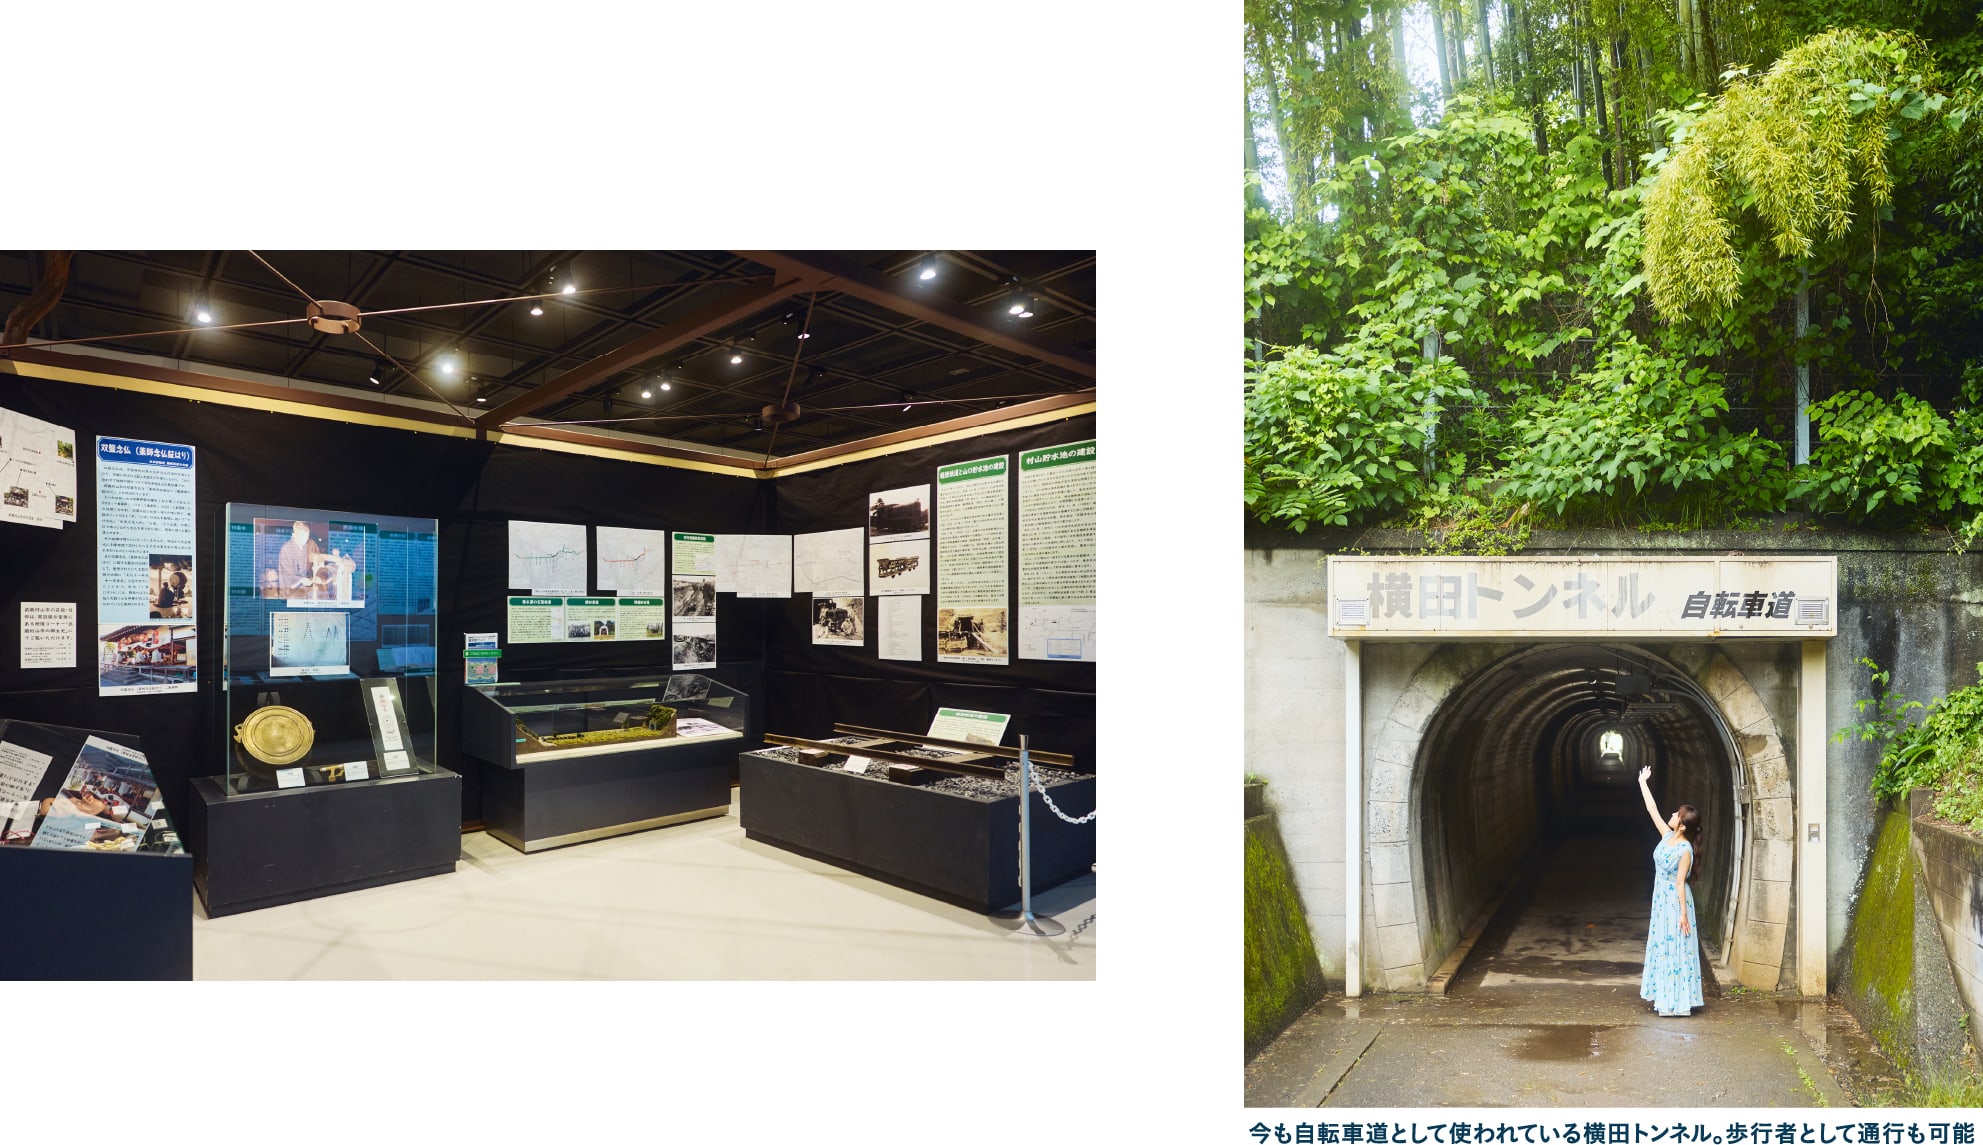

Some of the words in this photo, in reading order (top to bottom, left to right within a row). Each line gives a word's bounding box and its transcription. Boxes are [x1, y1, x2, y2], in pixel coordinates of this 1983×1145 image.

[1026, 446, 1096, 464] 村山貯水池の建設
[1367, 572, 1656, 620] 横田トンネル
[1681, 590, 1795, 620] 自転車道
